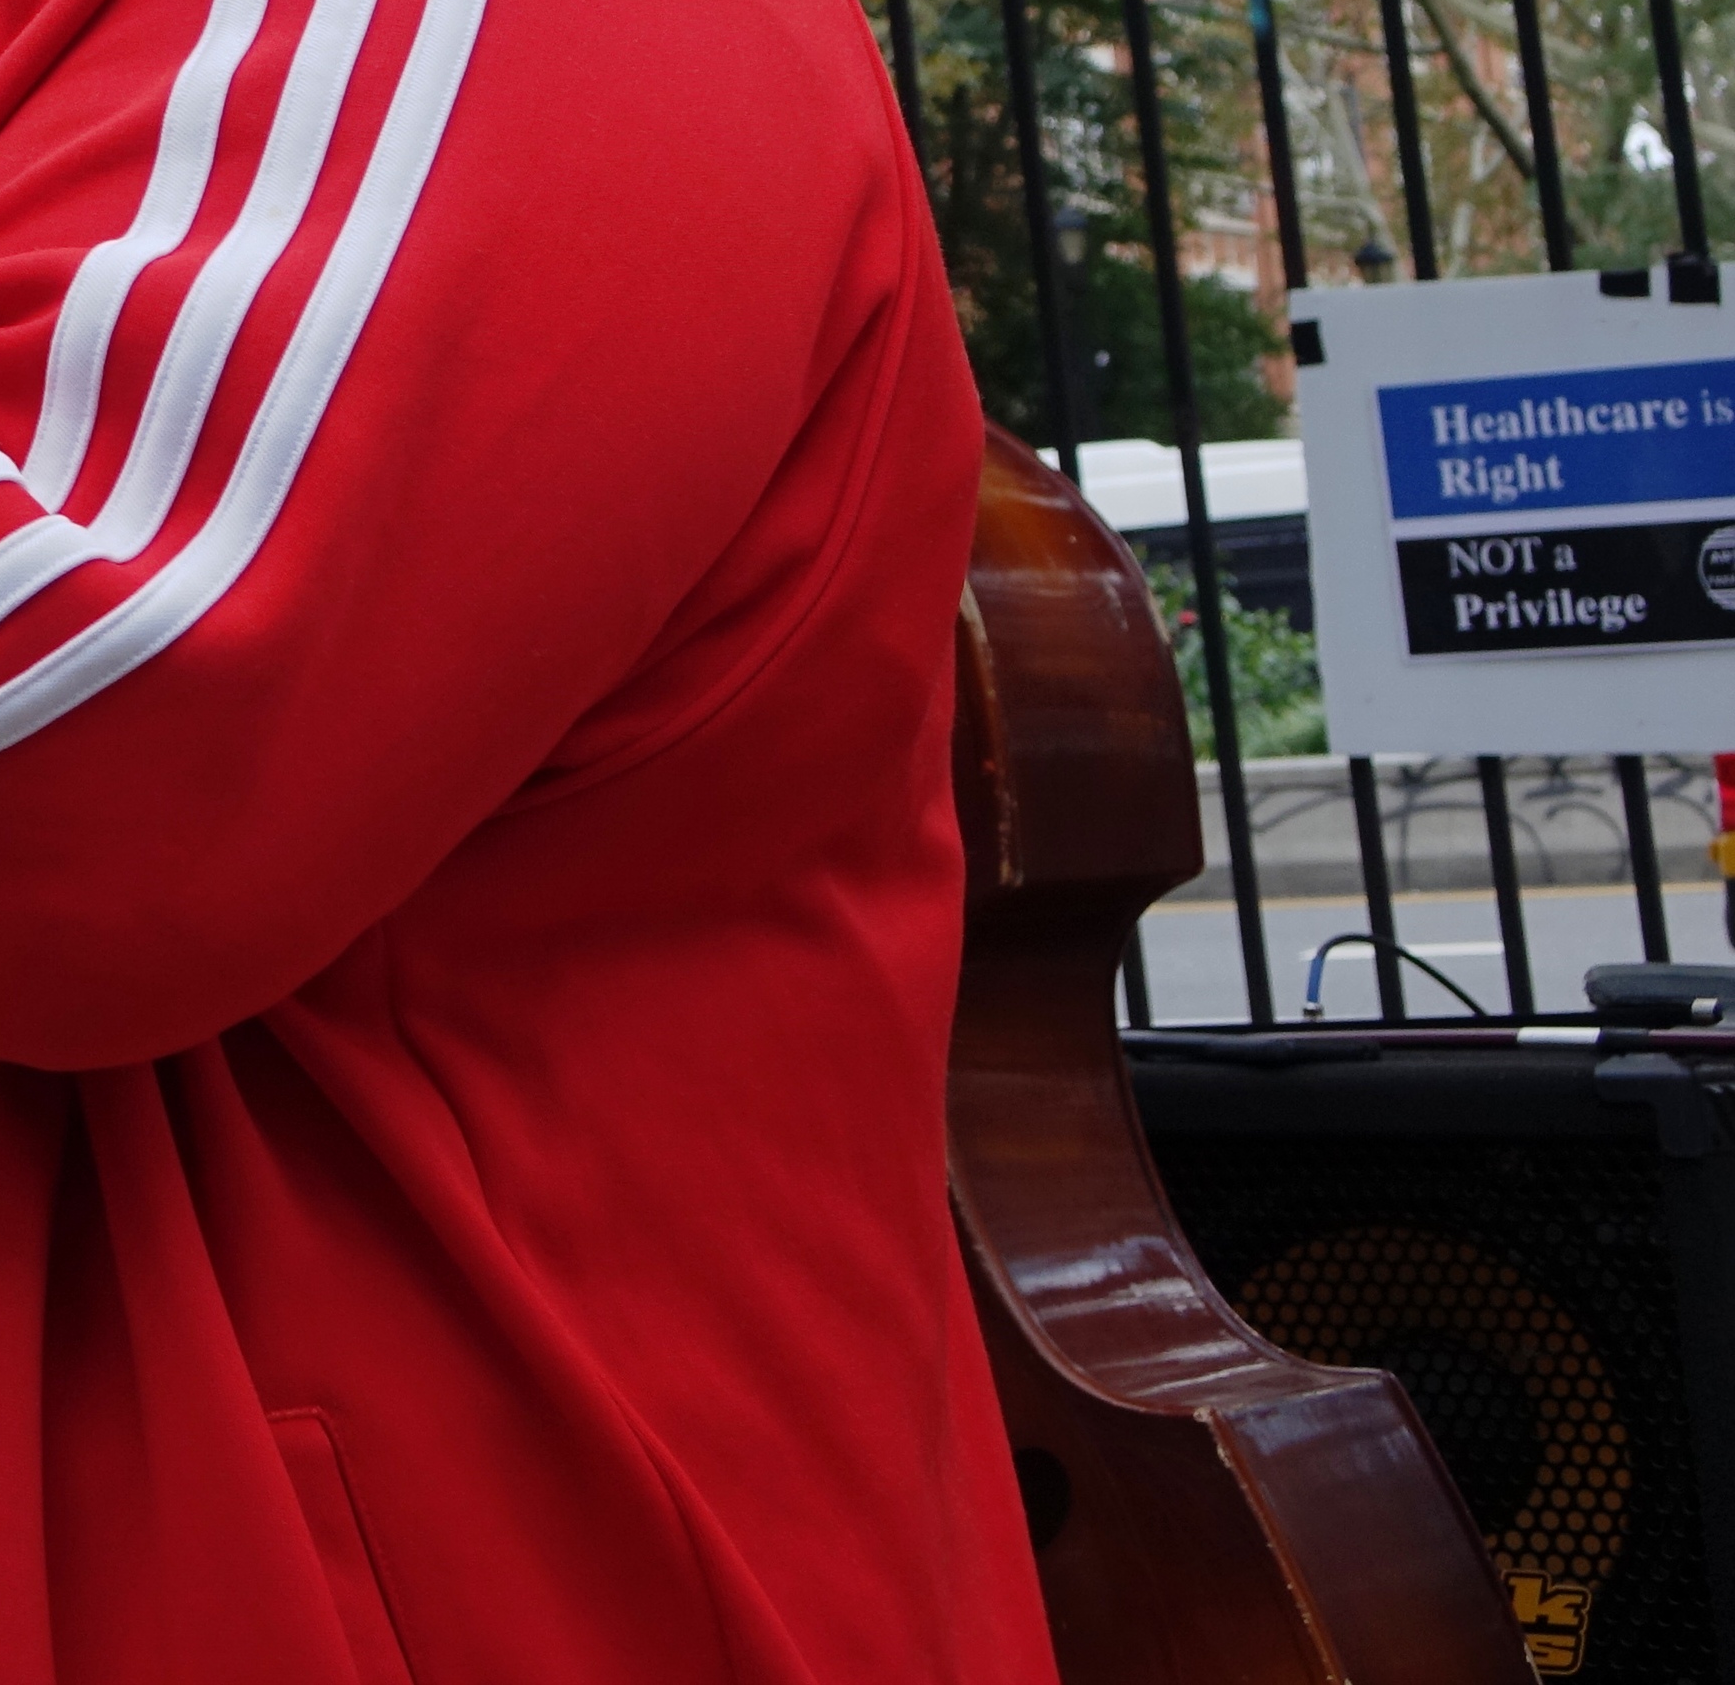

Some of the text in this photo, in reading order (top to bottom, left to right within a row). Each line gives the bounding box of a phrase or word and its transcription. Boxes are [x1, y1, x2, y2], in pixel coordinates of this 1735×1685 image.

[1431, 388, 1735, 445] Healthcare is
[1438, 453, 1565, 503] Right
[1448, 534, 1577, 578] NOT a
[1454, 588, 1647, 632] Privilege
